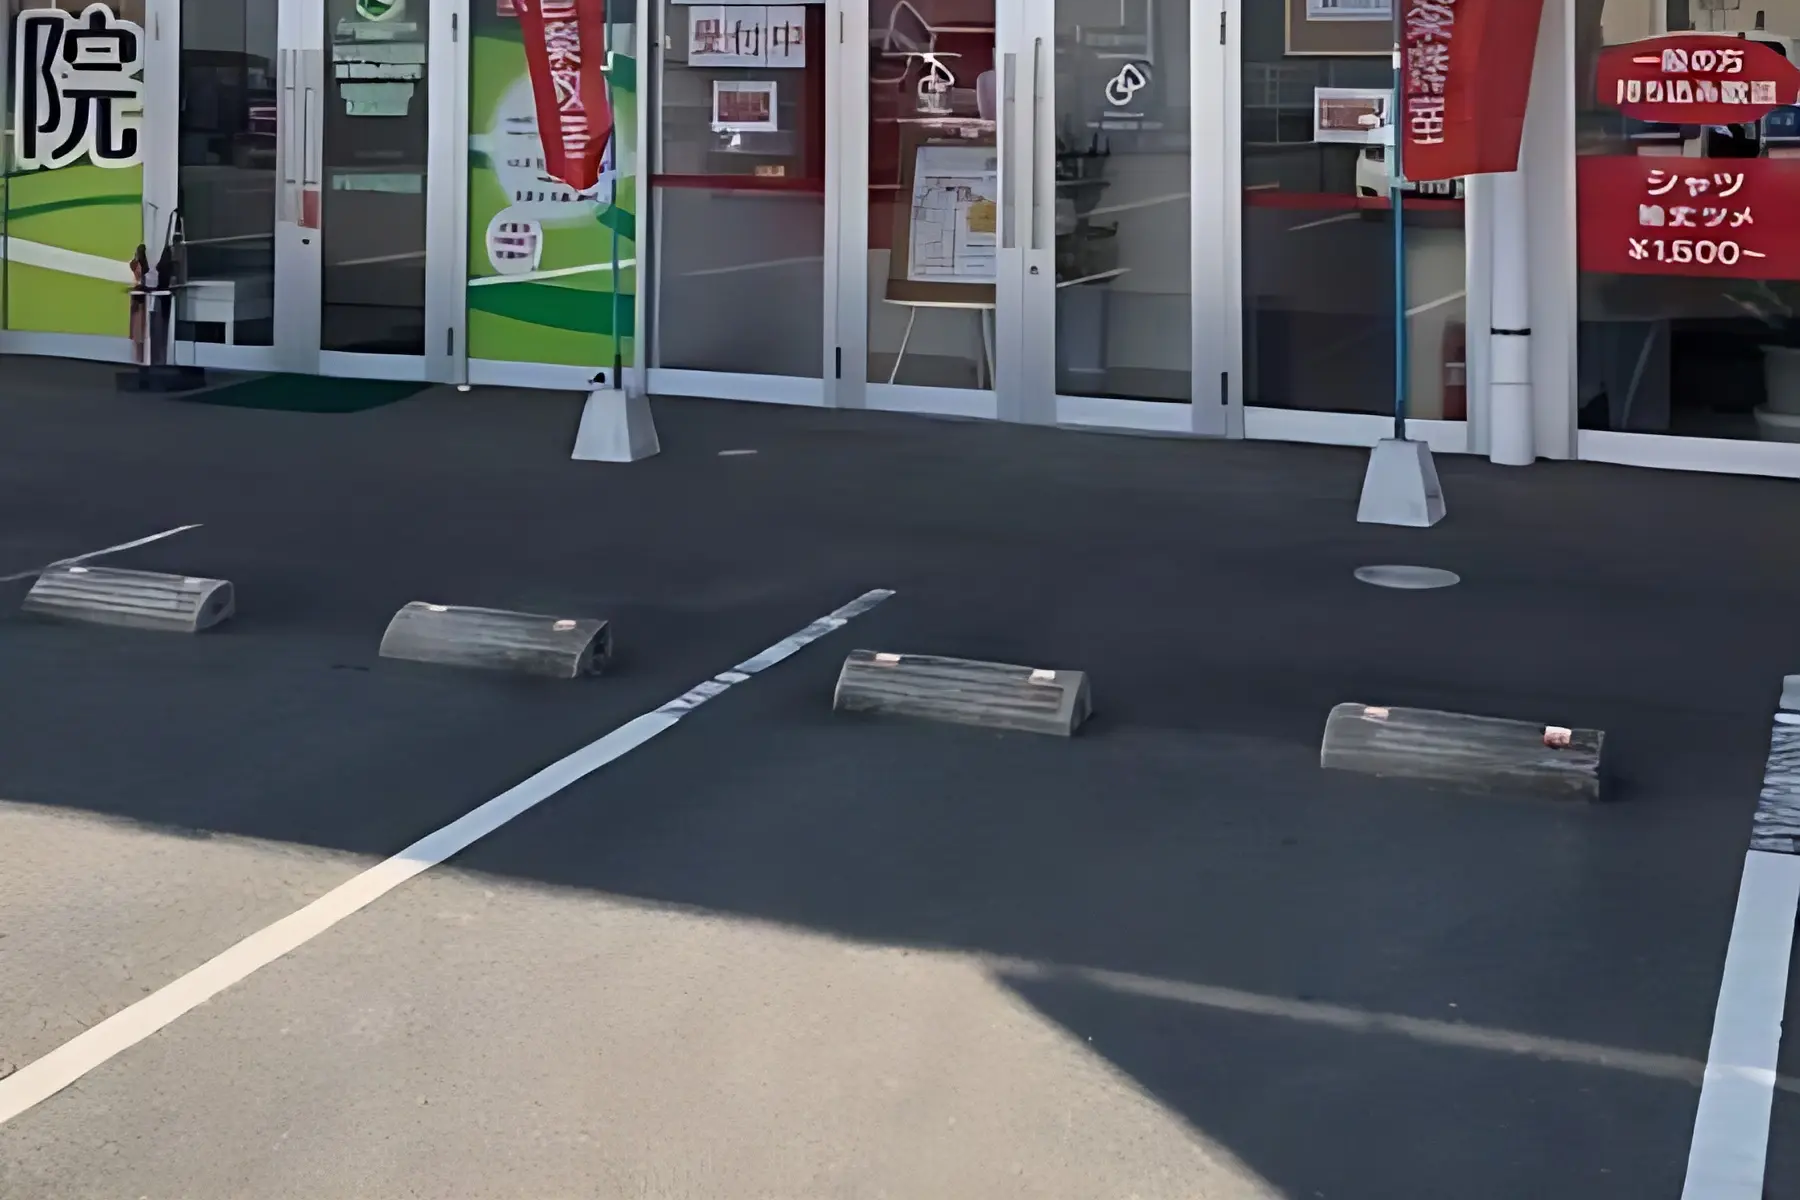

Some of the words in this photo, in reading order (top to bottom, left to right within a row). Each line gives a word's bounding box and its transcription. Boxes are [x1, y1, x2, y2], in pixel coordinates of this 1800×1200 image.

[22, 9, 138, 160] 院
[1647, 169, 1745, 197] シャツ
